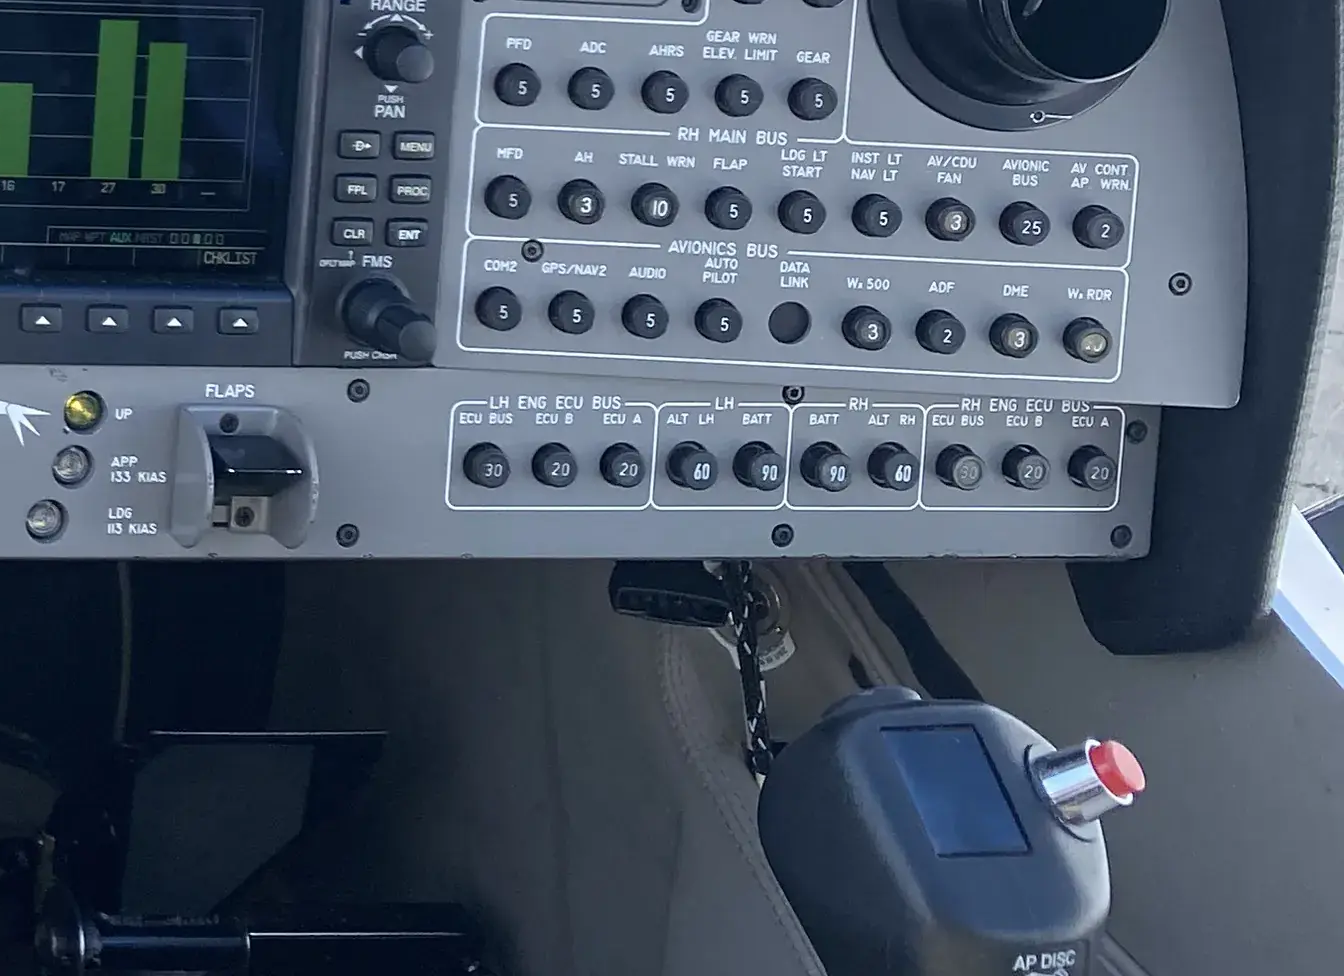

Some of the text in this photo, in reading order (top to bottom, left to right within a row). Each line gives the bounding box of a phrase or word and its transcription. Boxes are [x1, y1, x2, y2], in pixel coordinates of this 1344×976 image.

[579, 41, 607, 54] ADC
[677, 126, 788, 146] RH MAIN BUS
[713, 157, 748, 170] FLAP
[926, 155, 977, 169] AV/CDU
[667, 239, 779, 259] AVIONICS BUS
[203, 250, 258, 265] CHKLIST
[205, 383, 255, 398] FLAPS
[489, 395, 622, 410] LH ENG ECU BUS
[110, 455, 138, 468] APP
[110, 470, 167, 483] 133 KIAS
[830, 465, 846, 482] 90
[1012, 949, 1077, 972] AP DISC
